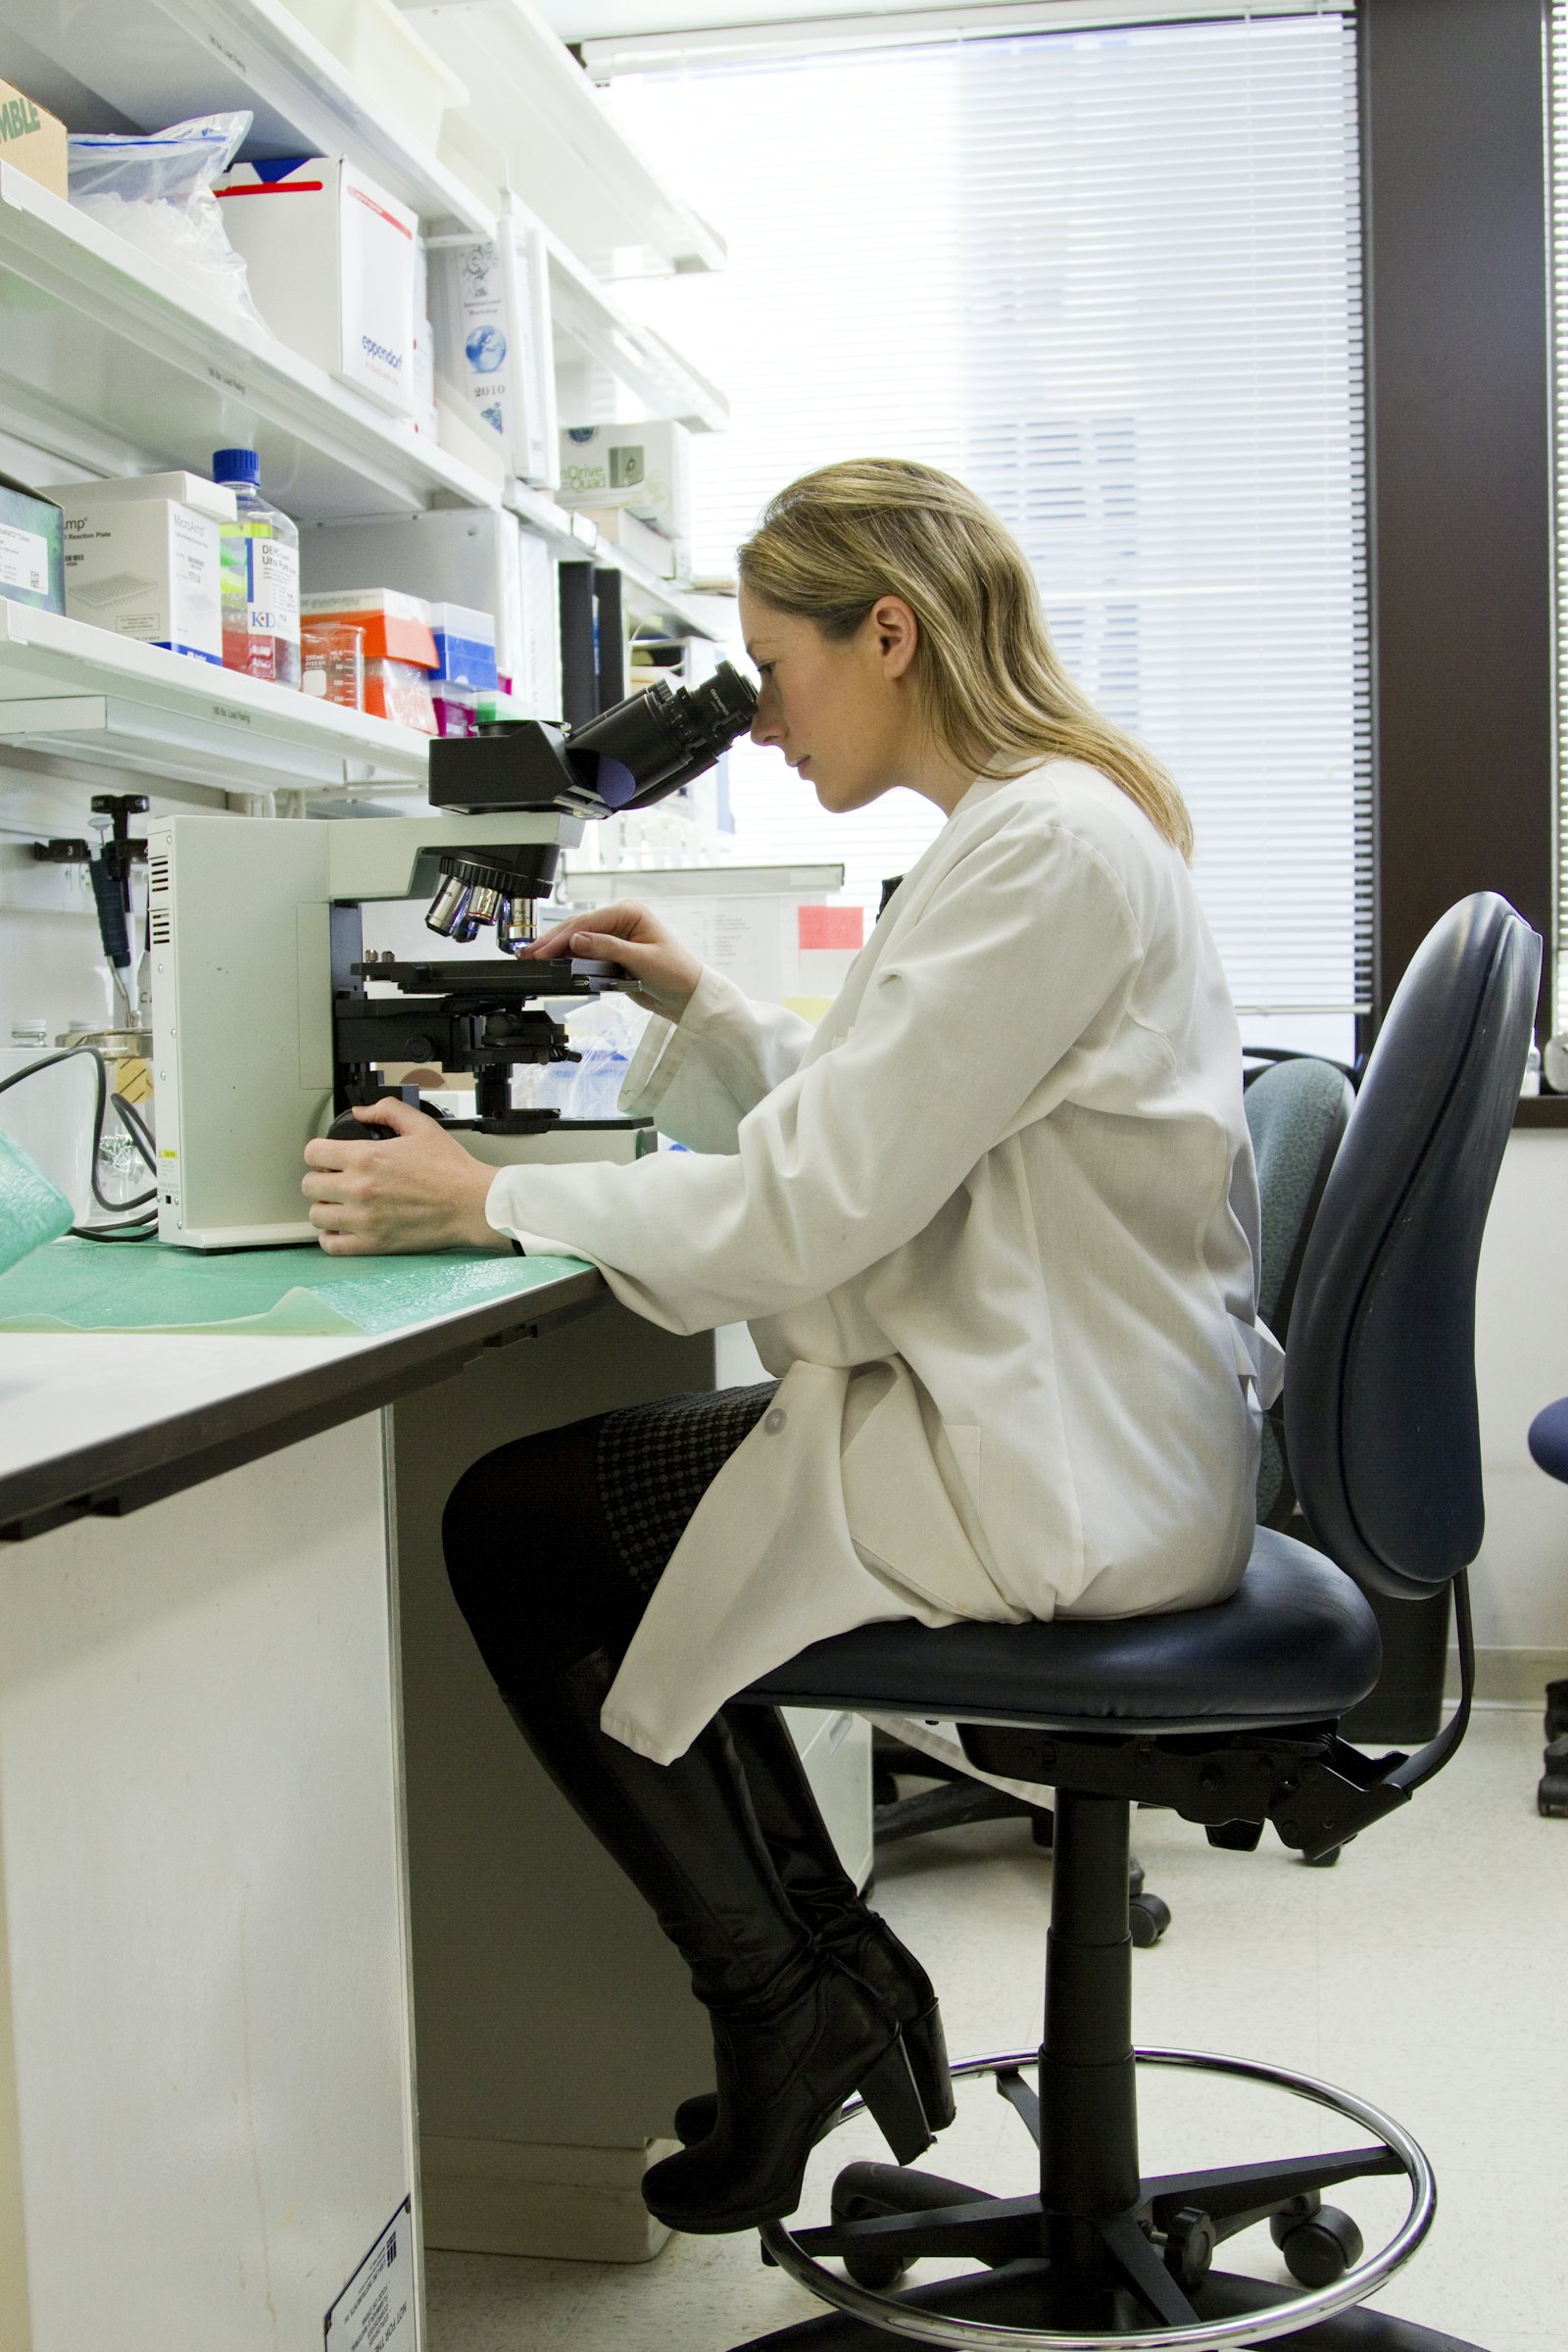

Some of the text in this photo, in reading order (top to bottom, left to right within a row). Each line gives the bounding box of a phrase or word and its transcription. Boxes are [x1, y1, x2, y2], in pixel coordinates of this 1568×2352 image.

[362, 334, 404, 371] eppendorf
[473, 384, 506, 397] 2010
[571, 474, 606, 494] Quad
[710, 688, 730, 716] OLYMPUS
[68, 845, 74, 857] 3
[377, 2282, 388, 2302] FOOD
[371, 2298, 378, 2311] OR
[396, 2299, 407, 2326] NOT
[362, 2306, 372, 2327] DRINK
[385, 2318, 396, 2341] FOR
